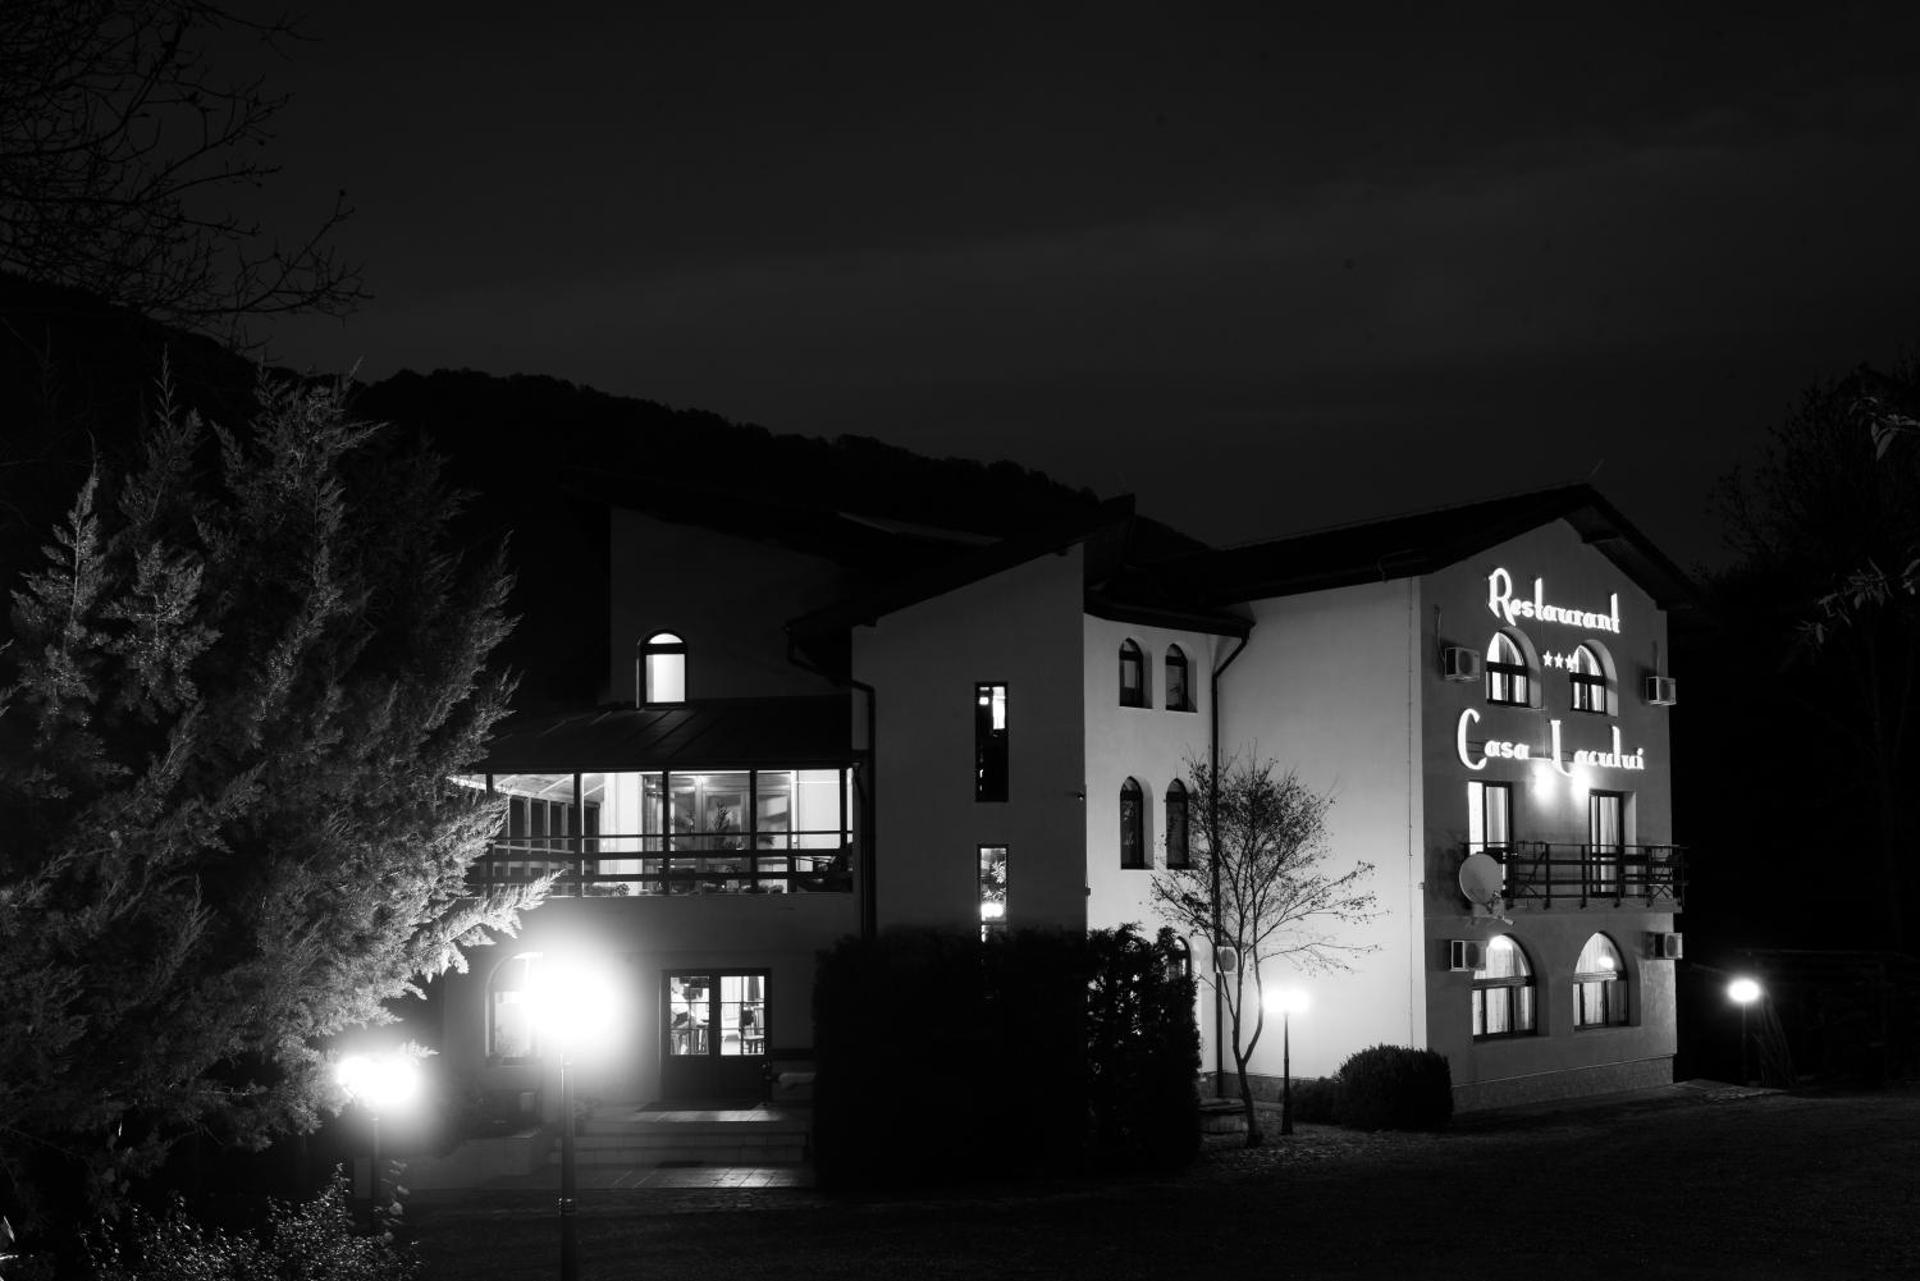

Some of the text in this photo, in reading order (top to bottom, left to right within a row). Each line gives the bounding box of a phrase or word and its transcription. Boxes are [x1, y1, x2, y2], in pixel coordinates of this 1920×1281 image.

[1488, 567, 1620, 634] Restaurant
[1457, 708, 1645, 776] Casa Lacului
